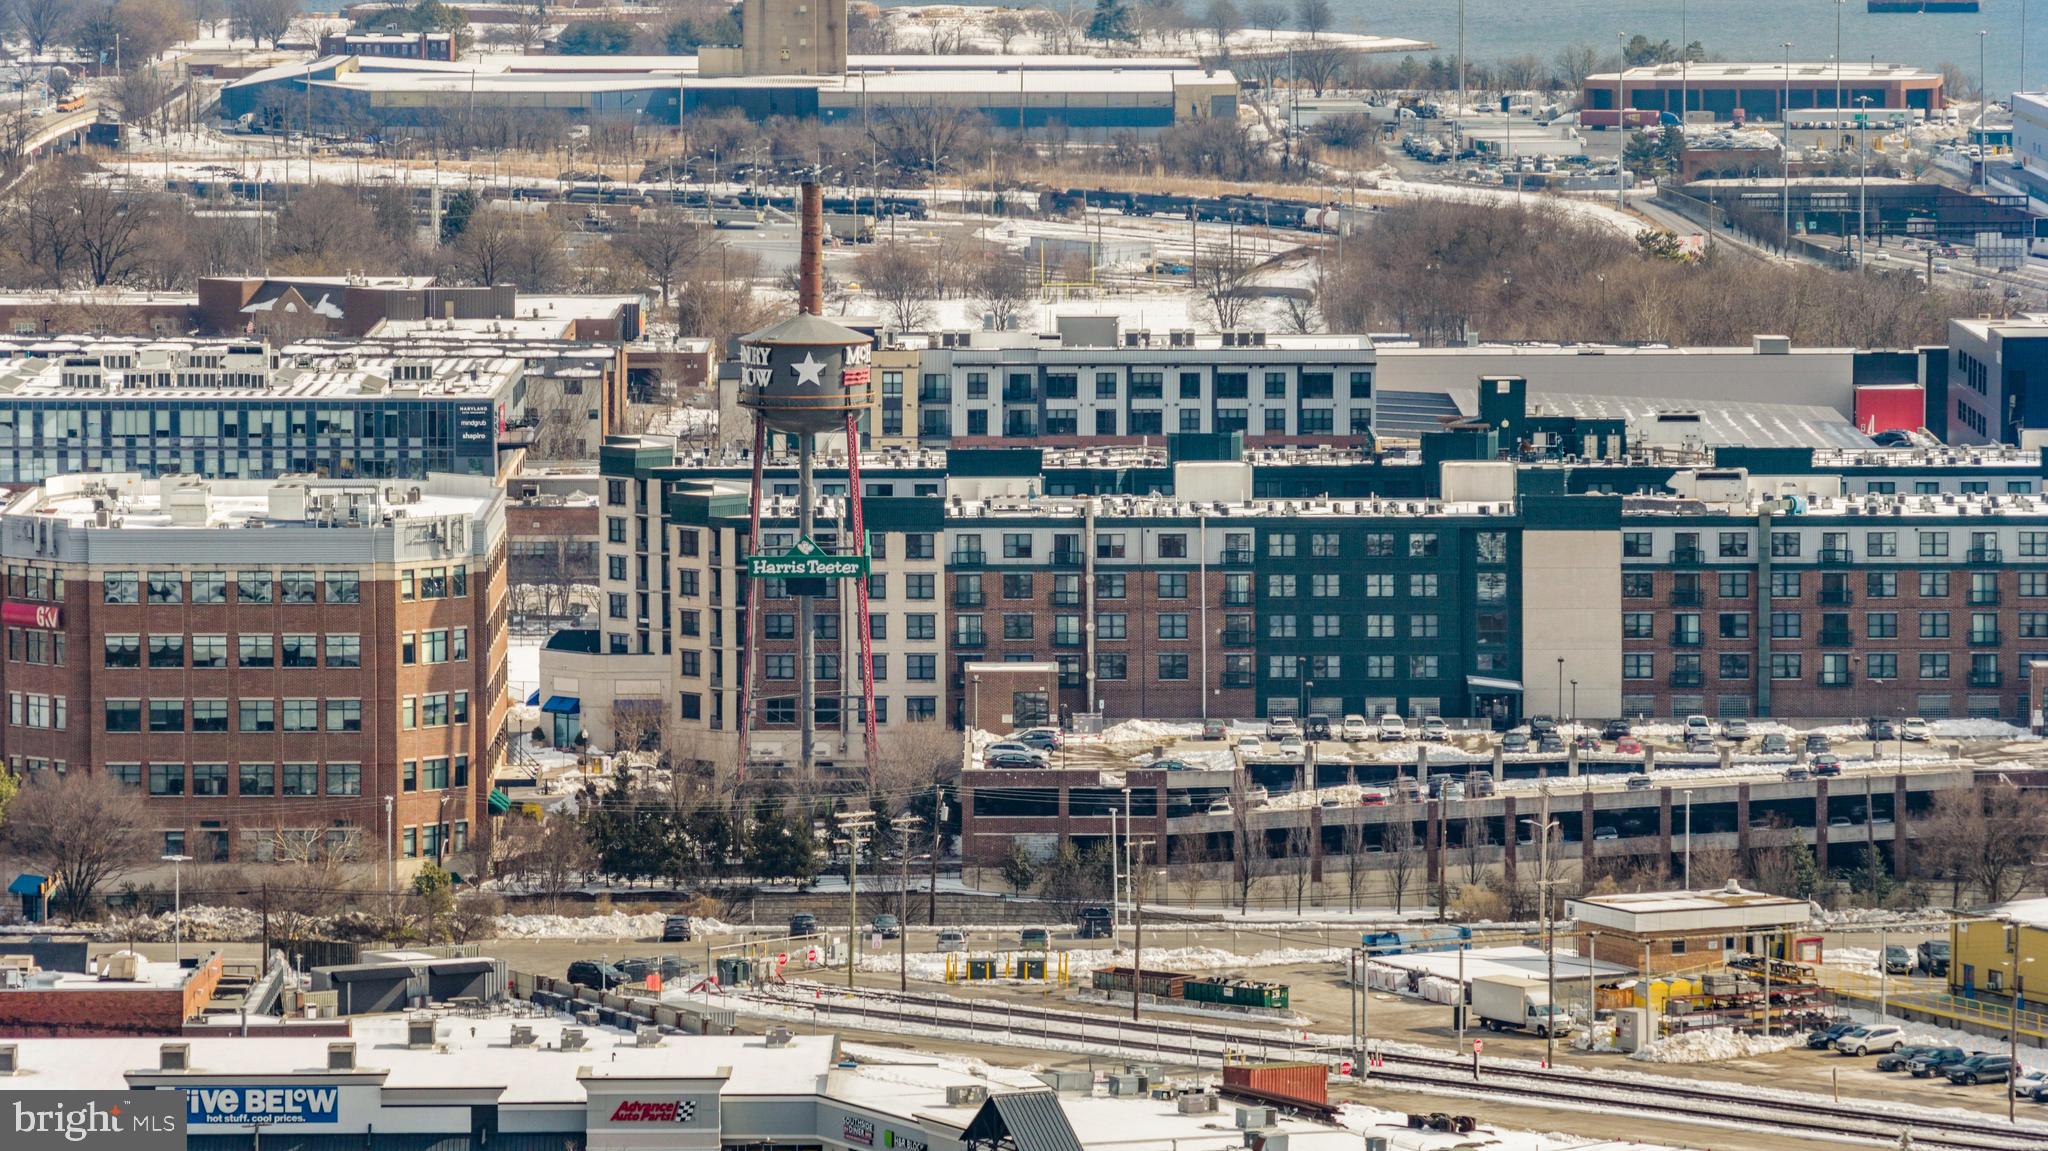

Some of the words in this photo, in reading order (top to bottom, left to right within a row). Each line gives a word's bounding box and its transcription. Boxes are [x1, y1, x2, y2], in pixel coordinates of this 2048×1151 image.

[461, 420, 487, 428] mindgrub
[462, 432, 486, 440] shapiro
[753, 560, 805, 574] Harris
[807, 560, 859, 574] Teeter
[187, 1089, 239, 1114] ive
[245, 1089, 337, 1113] BELOW
[619, 1101, 674, 1111] Advance
[206, 1114, 223, 1122] hot
[224, 1114, 250, 1122] stuff.
[251, 1114, 272, 1122] cool
[274, 1114, 306, 1124] prices.
[610, 1110, 640, 1121] Auto
[640, 1109, 674, 1121] Parts
